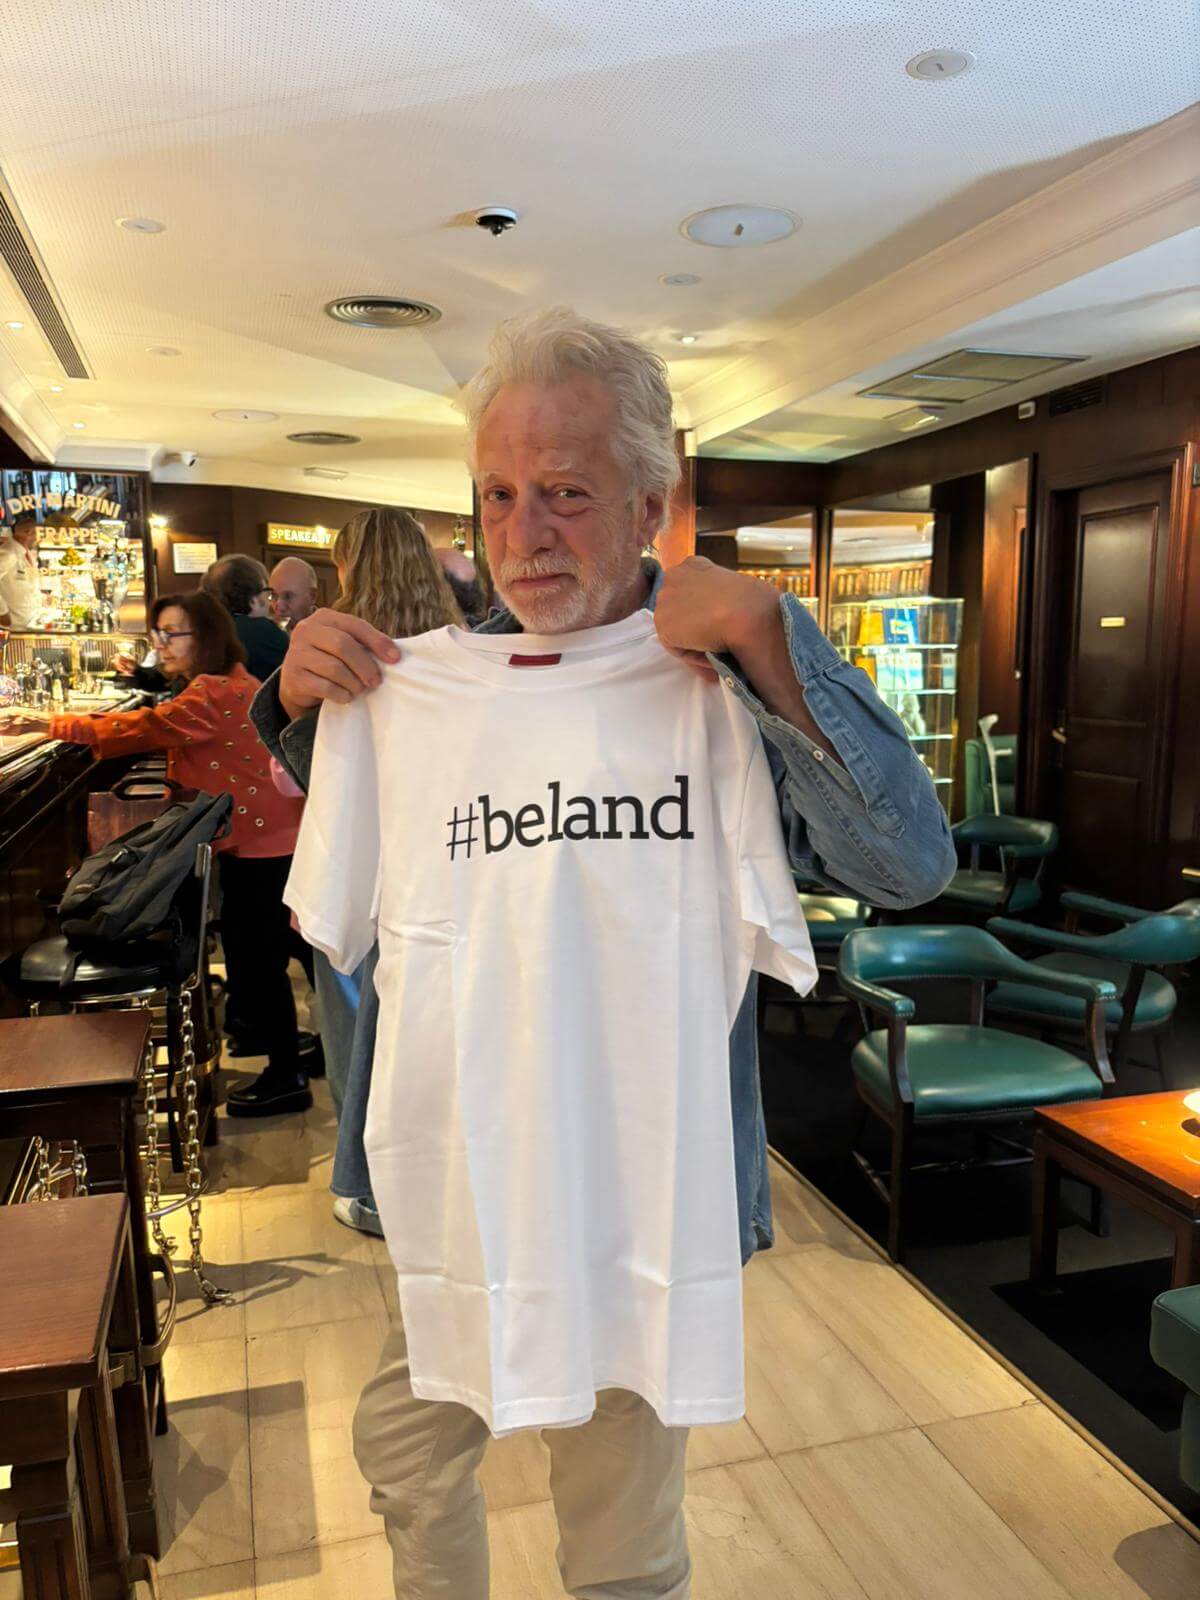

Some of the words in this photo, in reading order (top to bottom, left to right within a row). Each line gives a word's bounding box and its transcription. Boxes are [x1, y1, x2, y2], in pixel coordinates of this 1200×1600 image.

[6, 493, 43, 515] DRY
[46, 492, 121, 519] MARTINI
[446, 775, 695, 861] #beland
